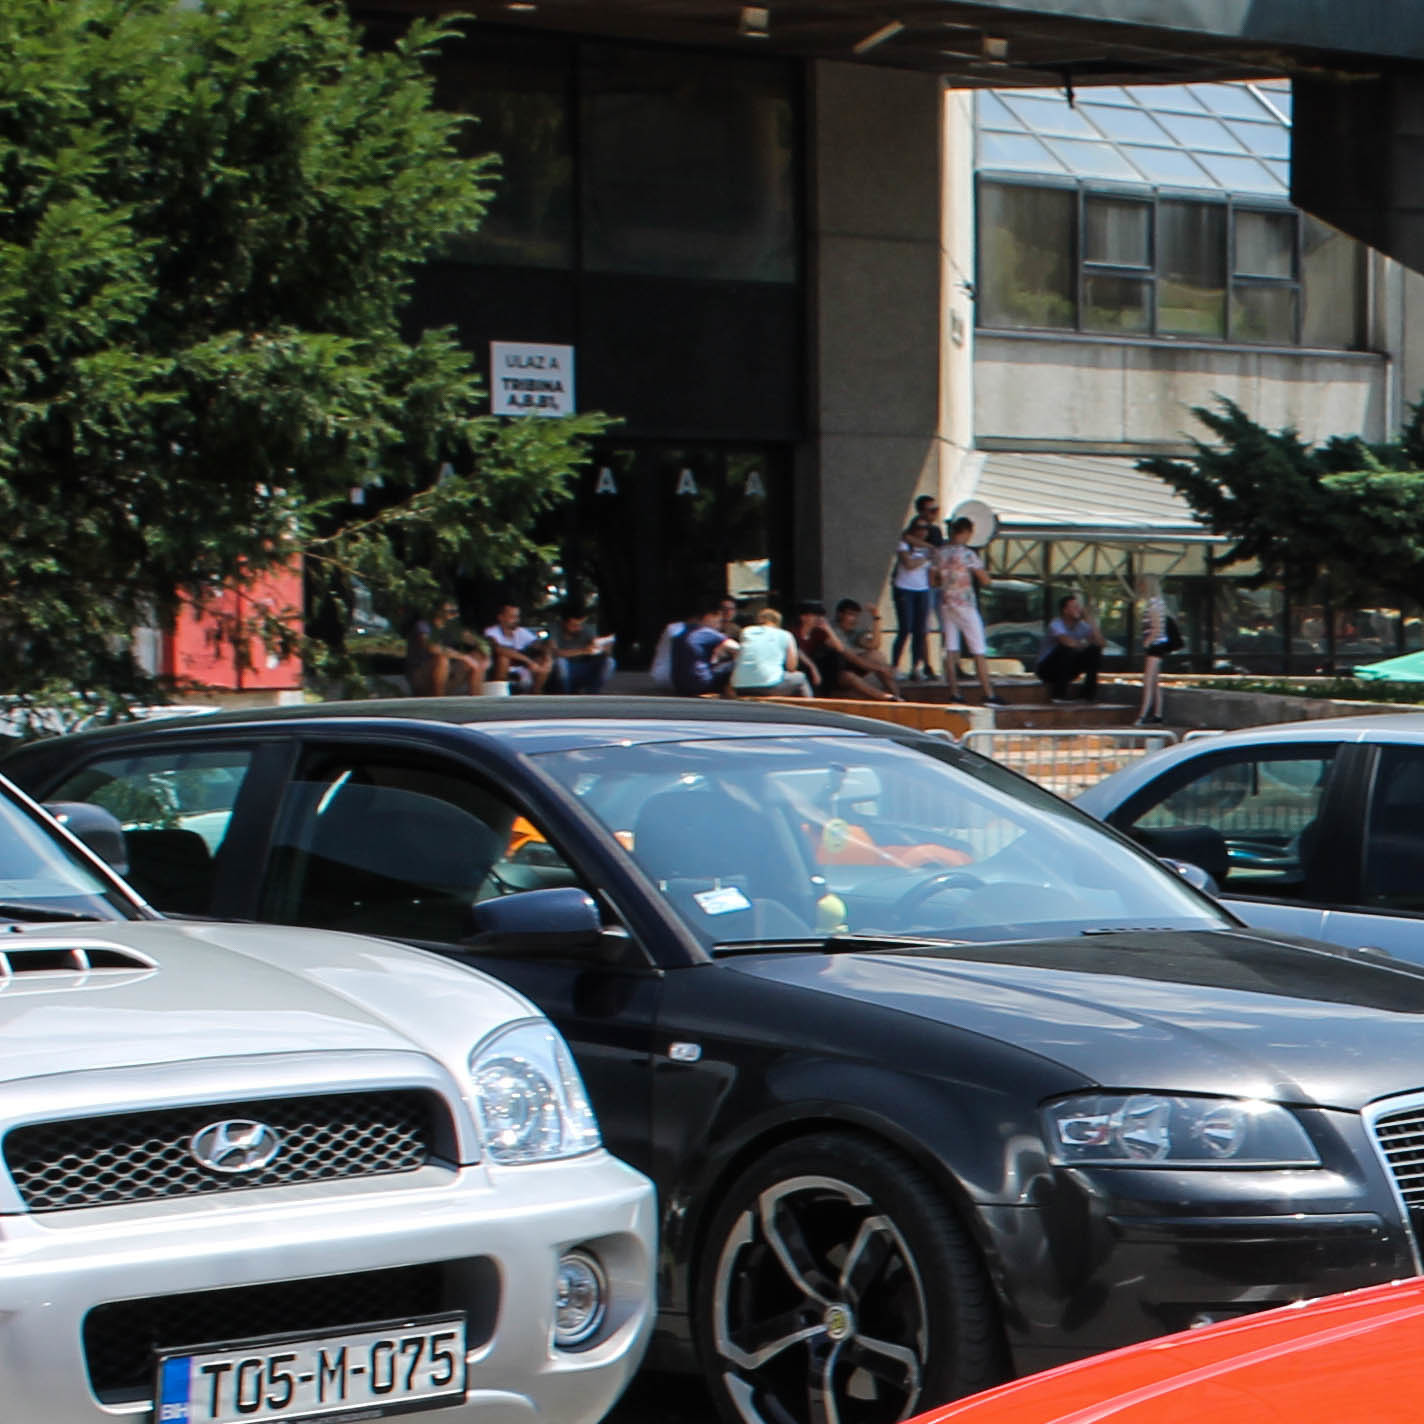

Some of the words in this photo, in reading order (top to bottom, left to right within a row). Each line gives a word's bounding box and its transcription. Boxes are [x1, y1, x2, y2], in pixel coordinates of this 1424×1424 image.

[595, 467, 617, 494] A
[675, 468, 699, 495] A
[744, 471, 766, 496] A
[200, 1332, 457, 1418] T05-M-075
